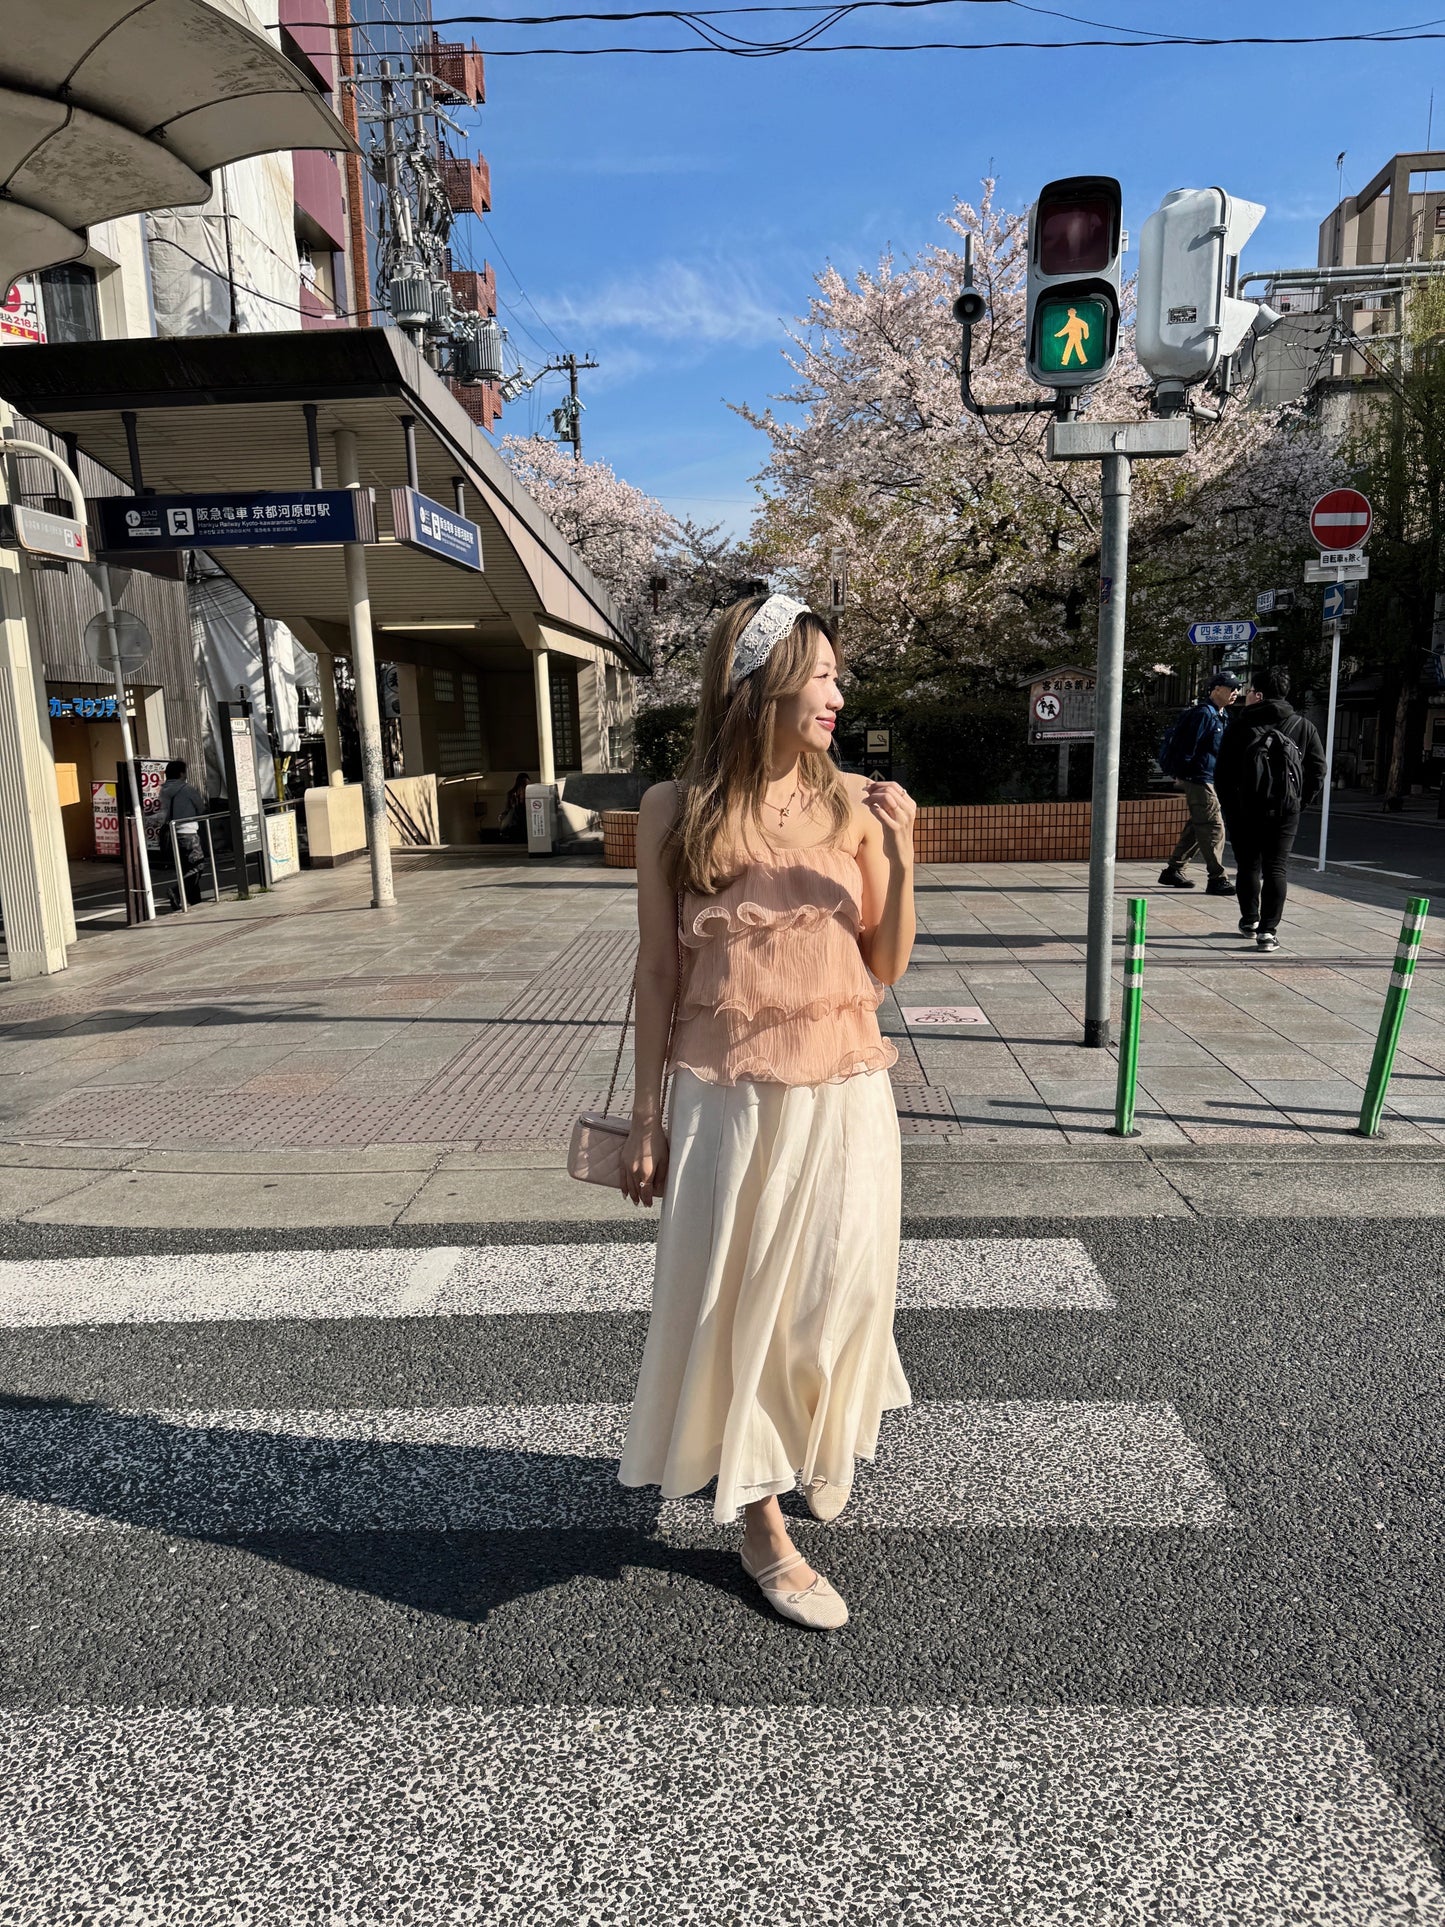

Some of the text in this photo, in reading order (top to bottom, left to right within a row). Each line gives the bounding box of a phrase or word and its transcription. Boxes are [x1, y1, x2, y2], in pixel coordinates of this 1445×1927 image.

[196, 503, 330, 521] 阪急電車 京都河原町駅
[1322, 553, 1361, 564] 自転車を除く
[1200, 624, 1245, 636] 四条通り
[49, 697, 121, 718] カーマウンテ
[95, 817, 118, 831] 500
